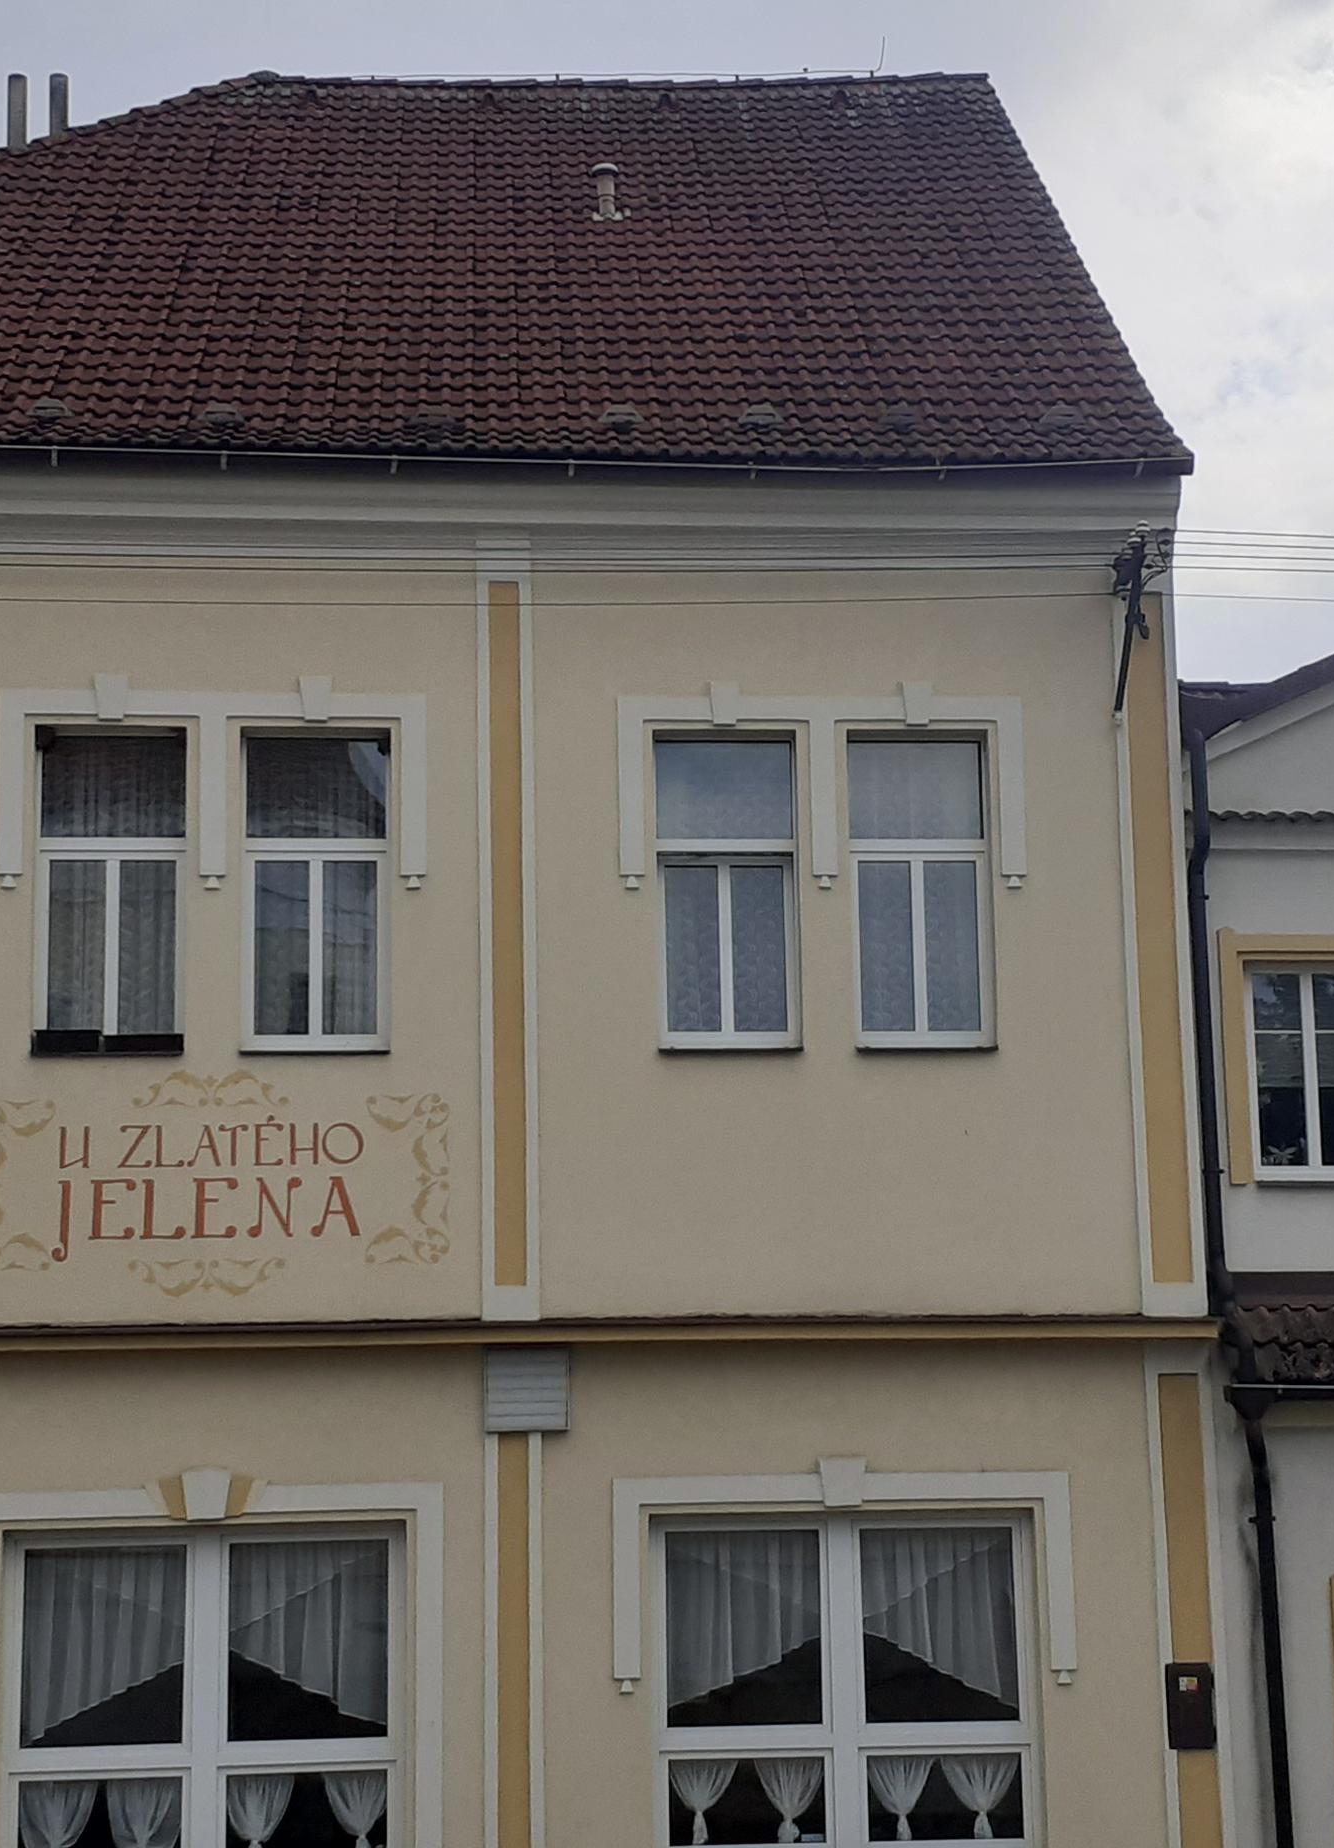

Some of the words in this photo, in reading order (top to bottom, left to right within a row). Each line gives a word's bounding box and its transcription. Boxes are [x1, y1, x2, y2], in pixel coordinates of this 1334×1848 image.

[58, 1126, 91, 1169] U
[117, 1114, 365, 1168] ZLATÉHO
[51, 1175, 361, 1262] JELENA
